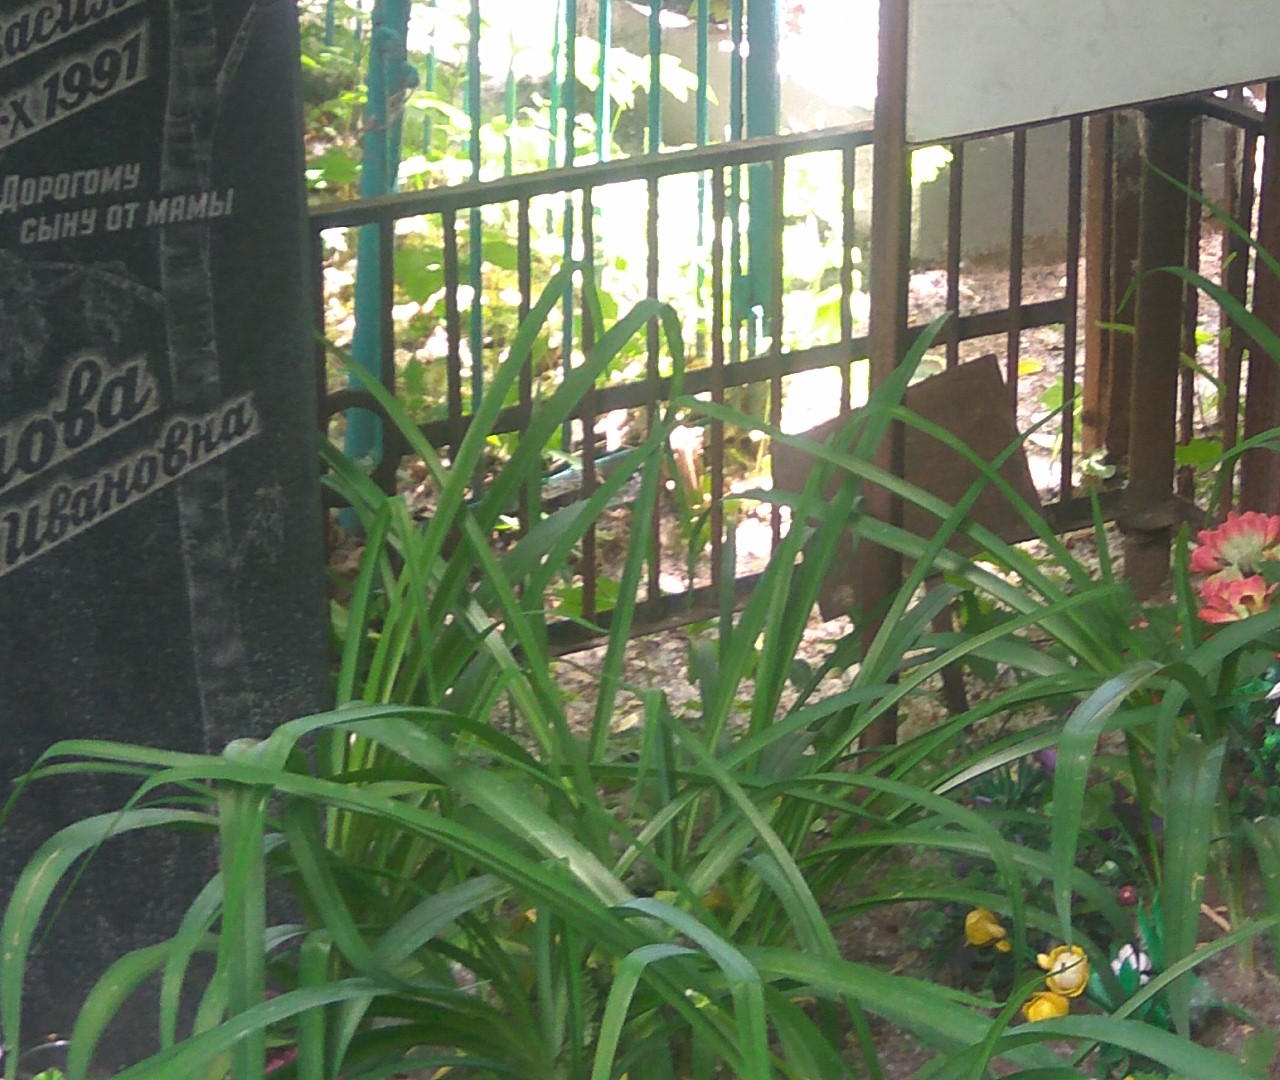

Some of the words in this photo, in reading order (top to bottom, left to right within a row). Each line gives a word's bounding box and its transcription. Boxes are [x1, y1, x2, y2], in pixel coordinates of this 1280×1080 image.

[42, 32, 142, 118] 1991
[20, 208, 96, 244] СЫНУ
[106, 202, 140, 231] ОТ
[146, 188, 234, 226] МАМЫ
[2, 398, 254, 565] Ивановна
